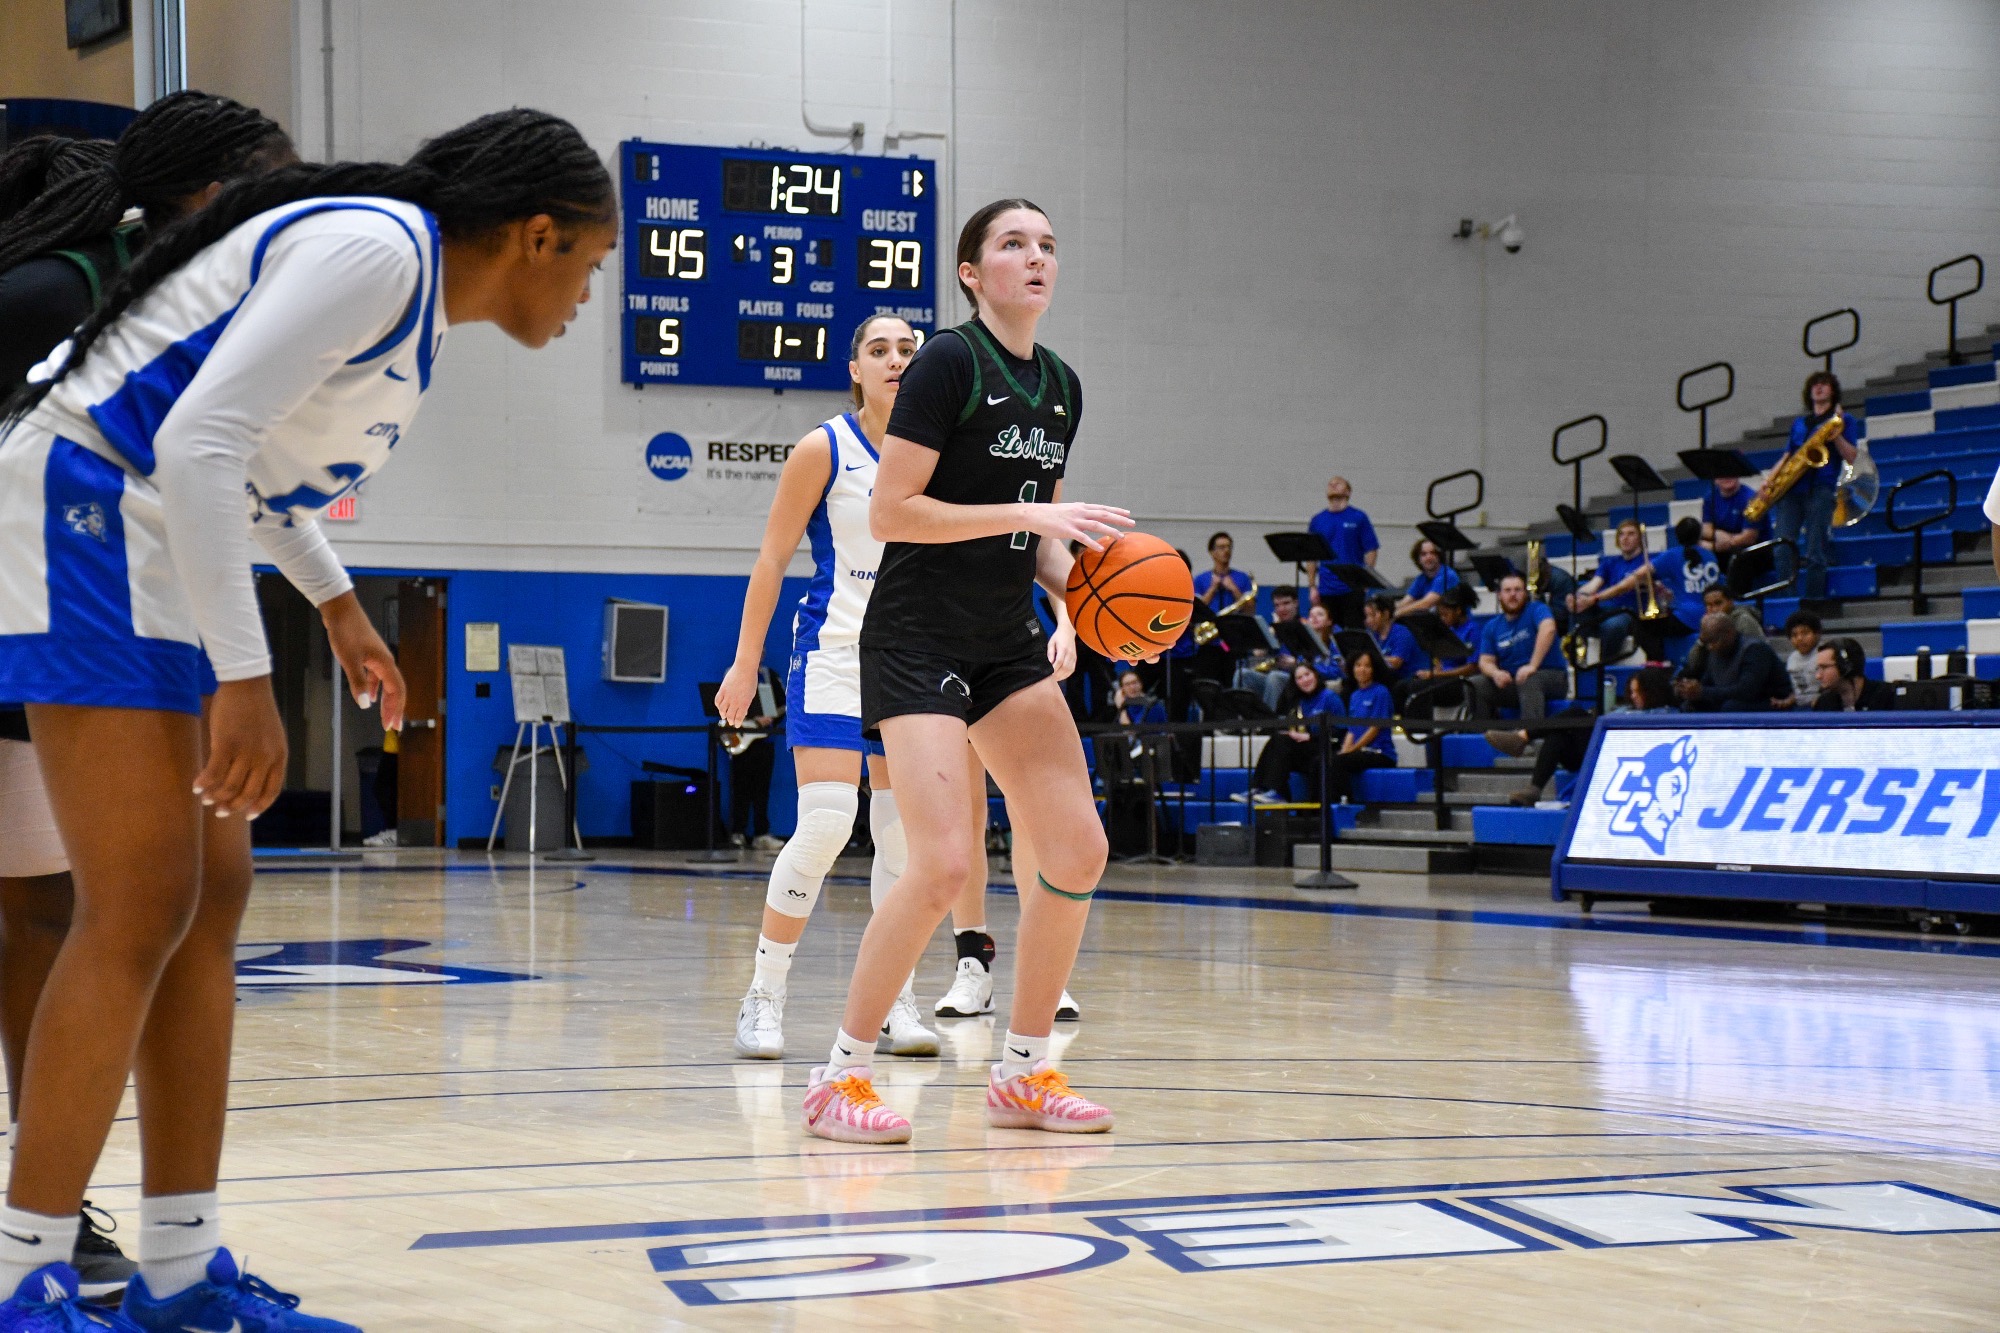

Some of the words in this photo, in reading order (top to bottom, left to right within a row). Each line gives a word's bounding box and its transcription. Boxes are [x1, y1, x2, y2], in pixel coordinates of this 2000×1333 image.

[771, 165, 840, 213] 1:24
[646, 197, 699, 221] HOME
[862, 209, 917, 232] GUEST
[764, 226, 802, 240] PERIOD
[650, 229, 704, 279] 45
[773, 247, 793, 283] 3
[867, 239, 921, 288] 39
[628, 294, 648, 310] TM
[652, 295, 690, 312] FOULS
[739, 300, 784, 317] PLAYER
[797, 302, 834, 319] FOULS
[659, 318, 679, 355] 5
[640, 361, 679, 377] POINTS
[764, 366, 802, 381] MATCH
[650, 454, 692, 470] NCAA
[707, 468, 722, 480] It's
[724, 468, 743, 480] the
[745, 471, 777, 482] name
[328, 498, 356, 519] EXIT
[1010, 480, 1038, 550] 1
[1683, 560, 1719, 584] GO
